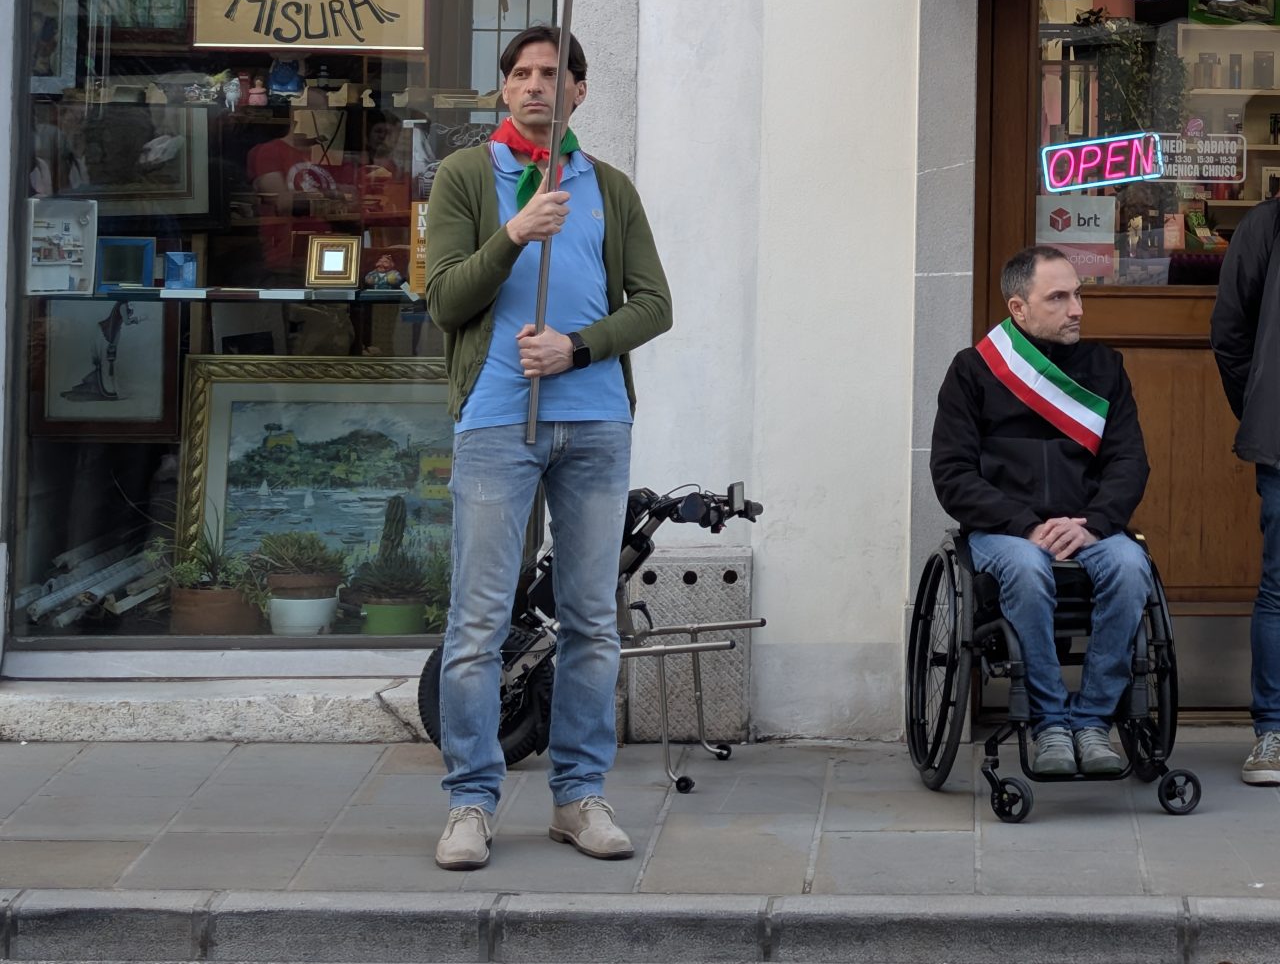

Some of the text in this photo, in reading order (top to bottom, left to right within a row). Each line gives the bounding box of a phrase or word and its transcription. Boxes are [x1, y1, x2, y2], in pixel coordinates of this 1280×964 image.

[1153, 139, 1187, 154] NEDÌ
[1196, 140, 1237, 154] SABATO
[1049, 137, 1155, 188] OPEN
[1202, 164, 1237, 178] CHIUSO
[1077, 213, 1100, 227] brt
